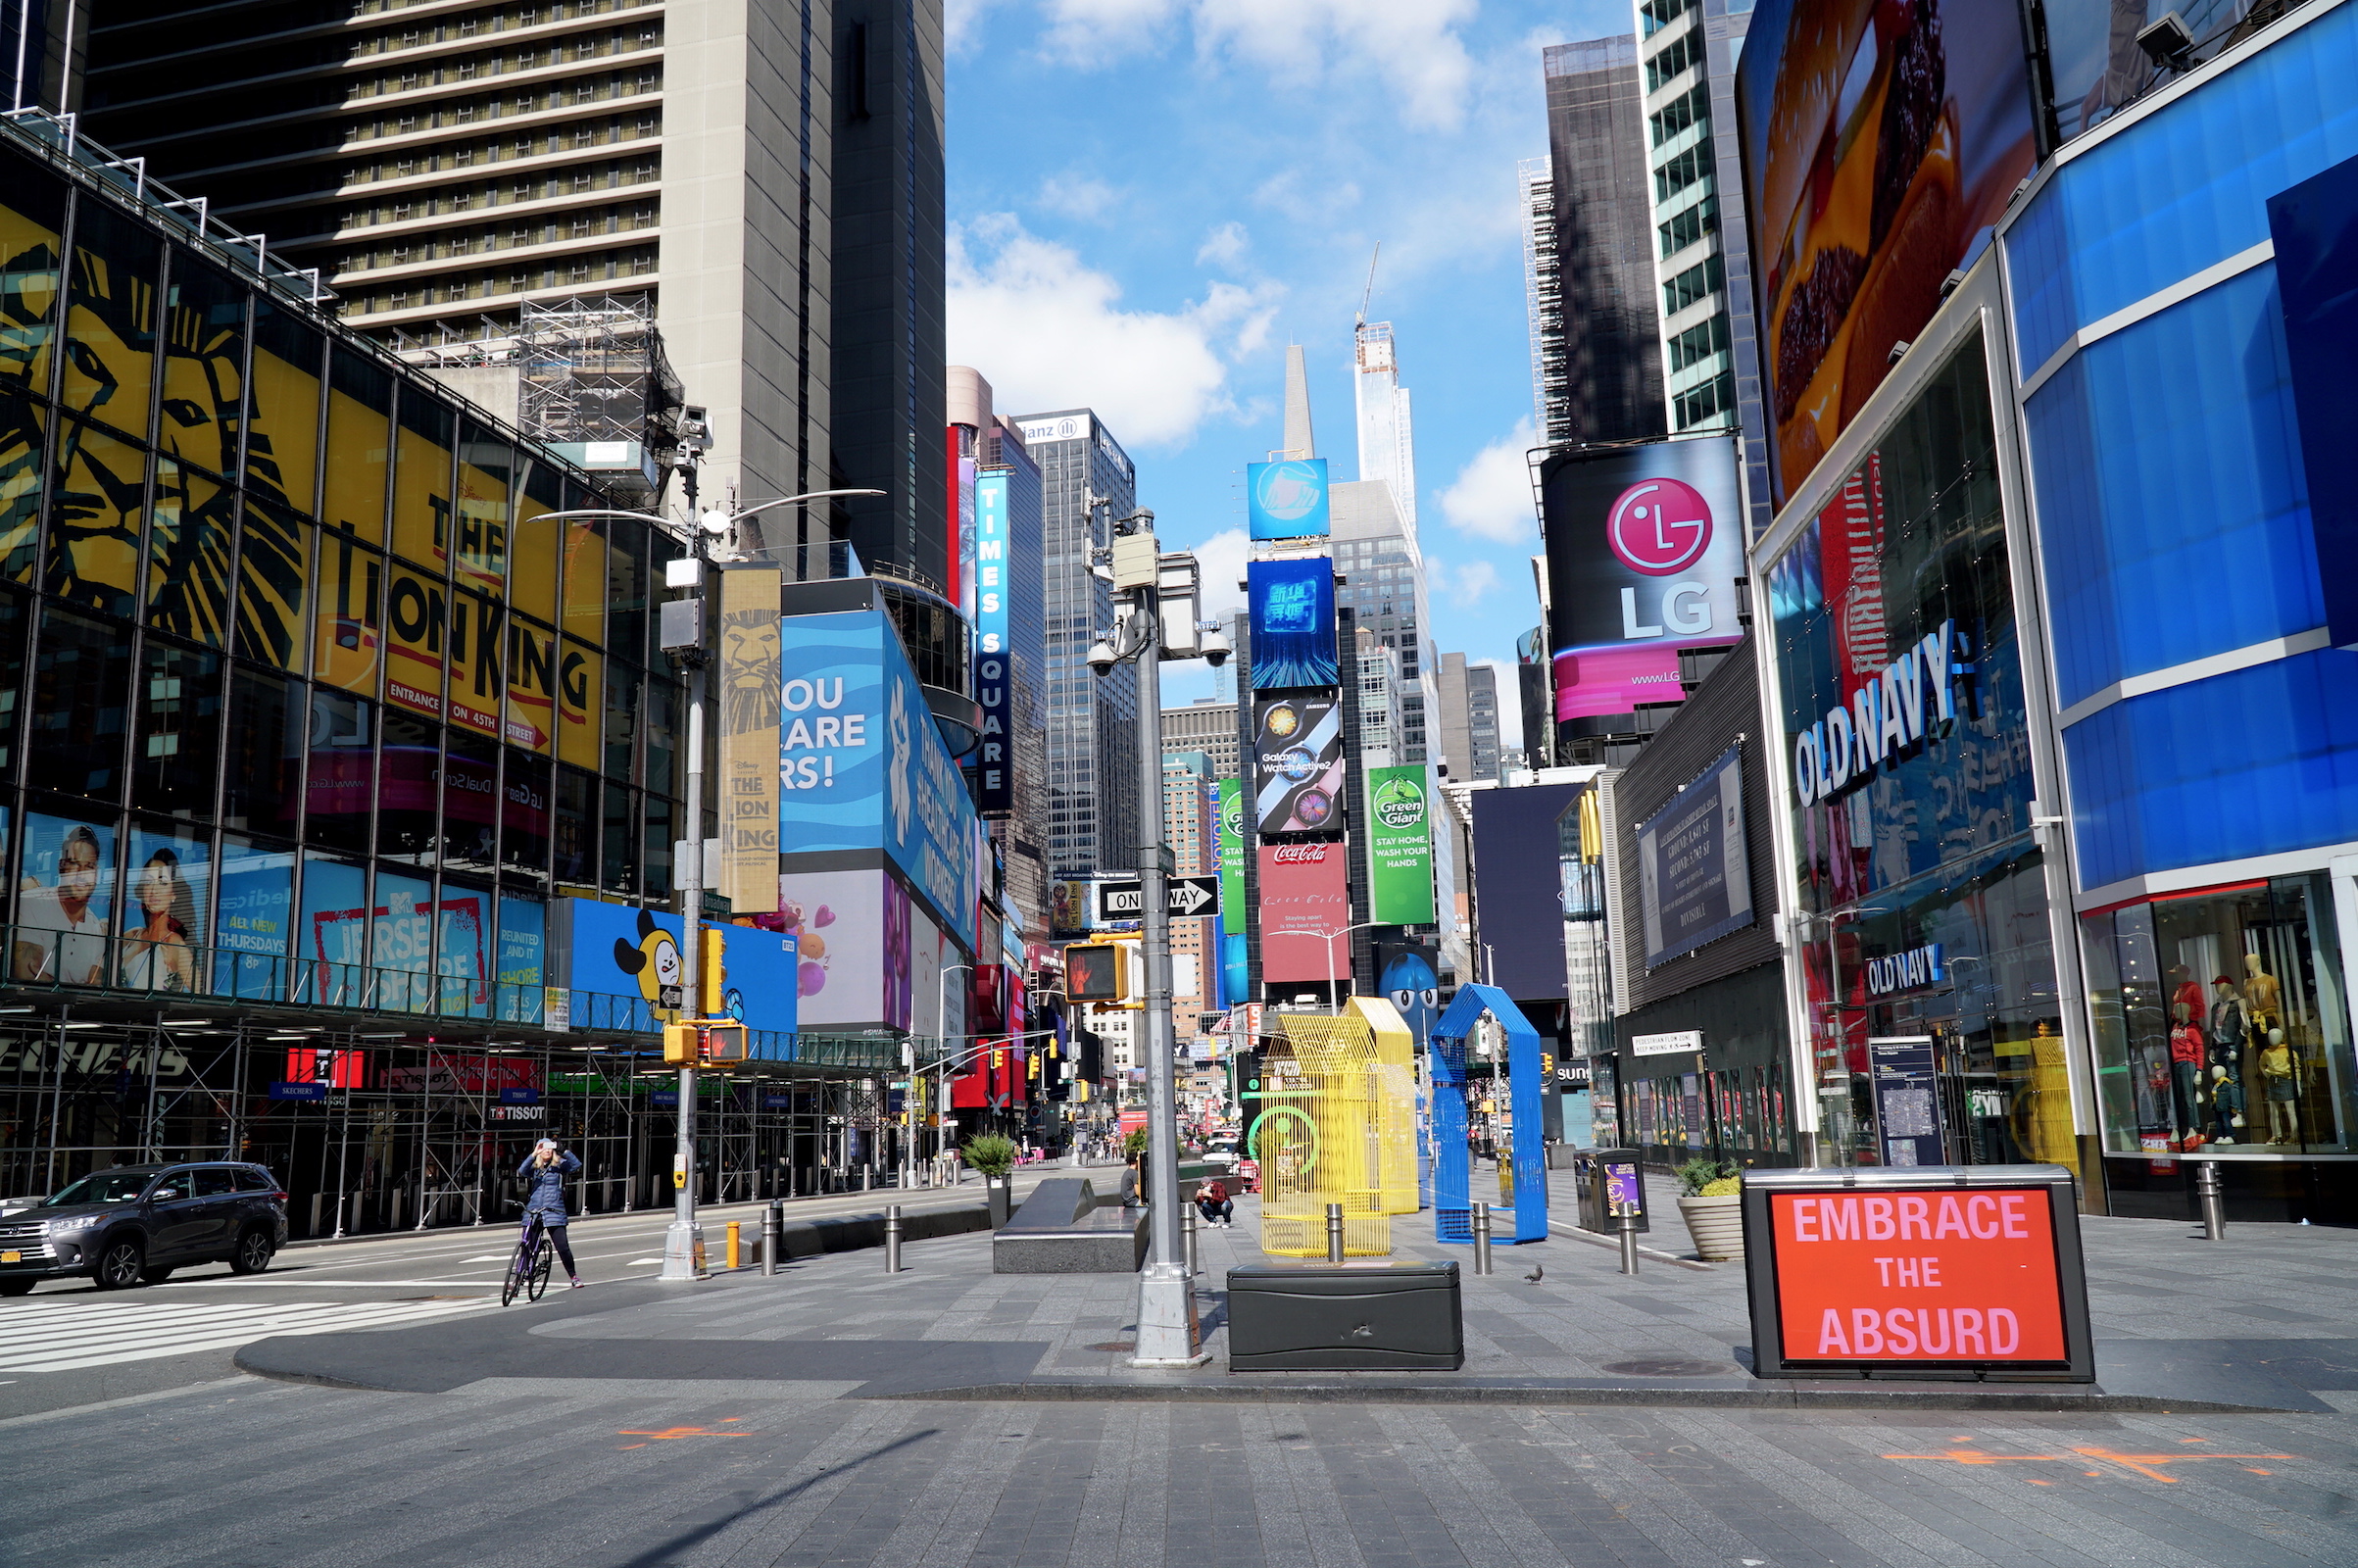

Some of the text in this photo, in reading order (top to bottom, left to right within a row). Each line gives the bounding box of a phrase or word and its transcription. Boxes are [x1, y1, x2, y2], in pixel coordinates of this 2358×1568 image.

[428, 492, 506, 576] THE
[335, 519, 587, 711] LION KING
[1620, 581, 1713, 639] LG
[1198, 620, 1218, 630] NYPD
[980, 488, 1004, 790] TIMES SQUARE
[1632, 671, 1680, 684] www.LG
[390, 683, 534, 742] ENTRANCE ON 45TH STREET
[1795, 705, 1852, 808] OLD
[1853, 617, 1954, 765] NAVY
[1262, 753, 1299, 764] Galaxy
[1263, 760, 1332, 773] Watch Active2
[731, 776, 763, 792] THE
[1380, 801, 1422, 813] Green
[1385, 811, 1424, 824] Giant
[1375, 835, 1428, 846] STAY HOME,
[1375, 847, 1428, 858] WASH YOUR
[1387, 858, 1418, 868] HANDS
[704, 895, 731, 913] Broadway
[1116, 893, 1142, 909] ON
[228, 915, 277, 933] ALL NEW
[218, 931, 286, 954] THURSDAYS
[336, 913, 452, 966] JERSEY
[501, 929, 540, 947] REUNITED
[506, 945, 534, 959] AND IT
[499, 967, 540, 990] SHORE
[1868, 944, 1936, 995] OLD NAVY
[377, 955, 468, 1004] SHORE
[547, 989, 568, 999] SPRING
[664, 991, 676, 1004] ONE
[1636, 1037, 1664, 1046] PEDESTRIAN
[506, 1106, 545, 1121] TISSOT
[1793, 1195, 2029, 1242] EMBRACE
[1873, 1256, 1942, 1288] THE
[1817, 1307, 2020, 1355] ABSURD
